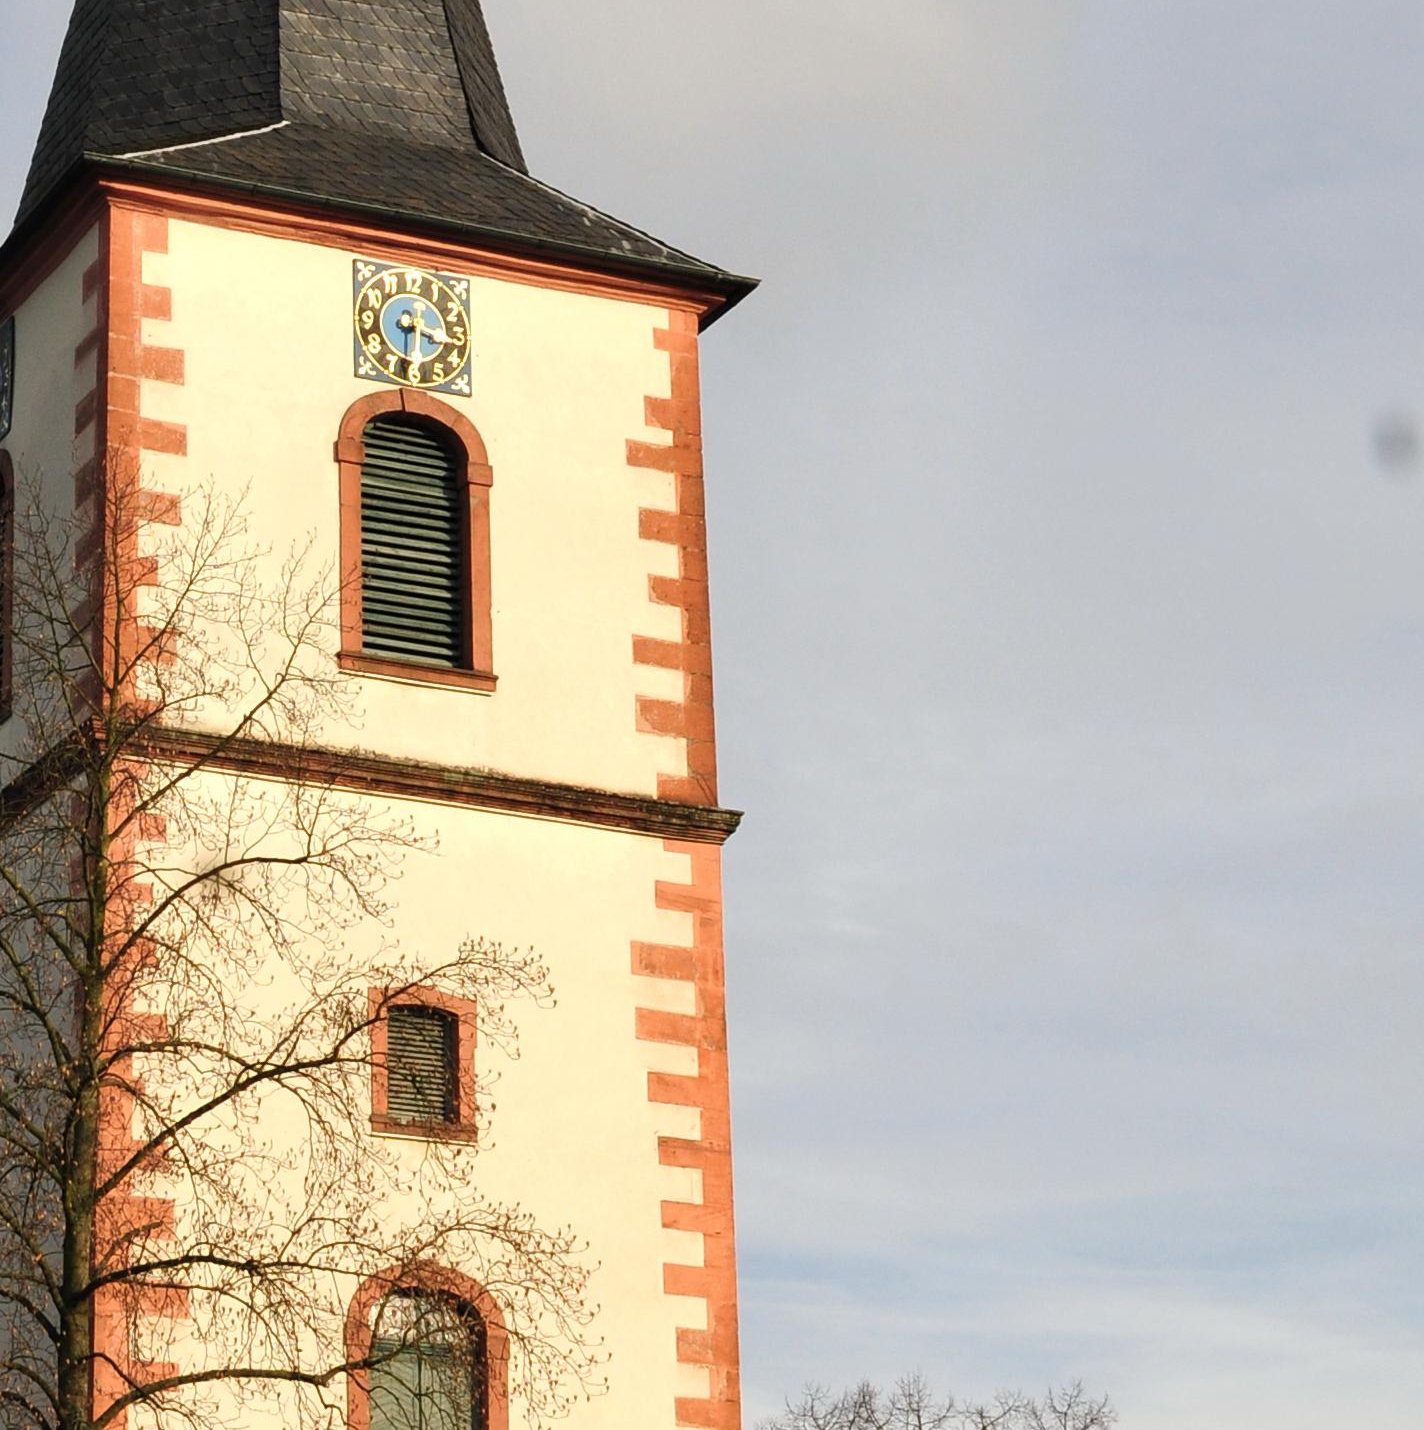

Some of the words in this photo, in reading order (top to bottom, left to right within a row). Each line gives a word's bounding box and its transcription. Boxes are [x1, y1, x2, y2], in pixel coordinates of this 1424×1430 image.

[383, 274, 398, 293] 11
[405, 272, 422, 293] 12
[367, 288, 382, 309] 10
[431, 283, 439, 302] 1
[362, 310, 374, 329] 9
[447, 302, 459, 322] 2
[368, 333, 381, 353] 8
[453, 327, 465, 346] 3
[386, 354, 398, 373] 7
[447, 349, 460, 367] 4
[408, 364, 421, 383] 6
[433, 362, 444, 381] 5
